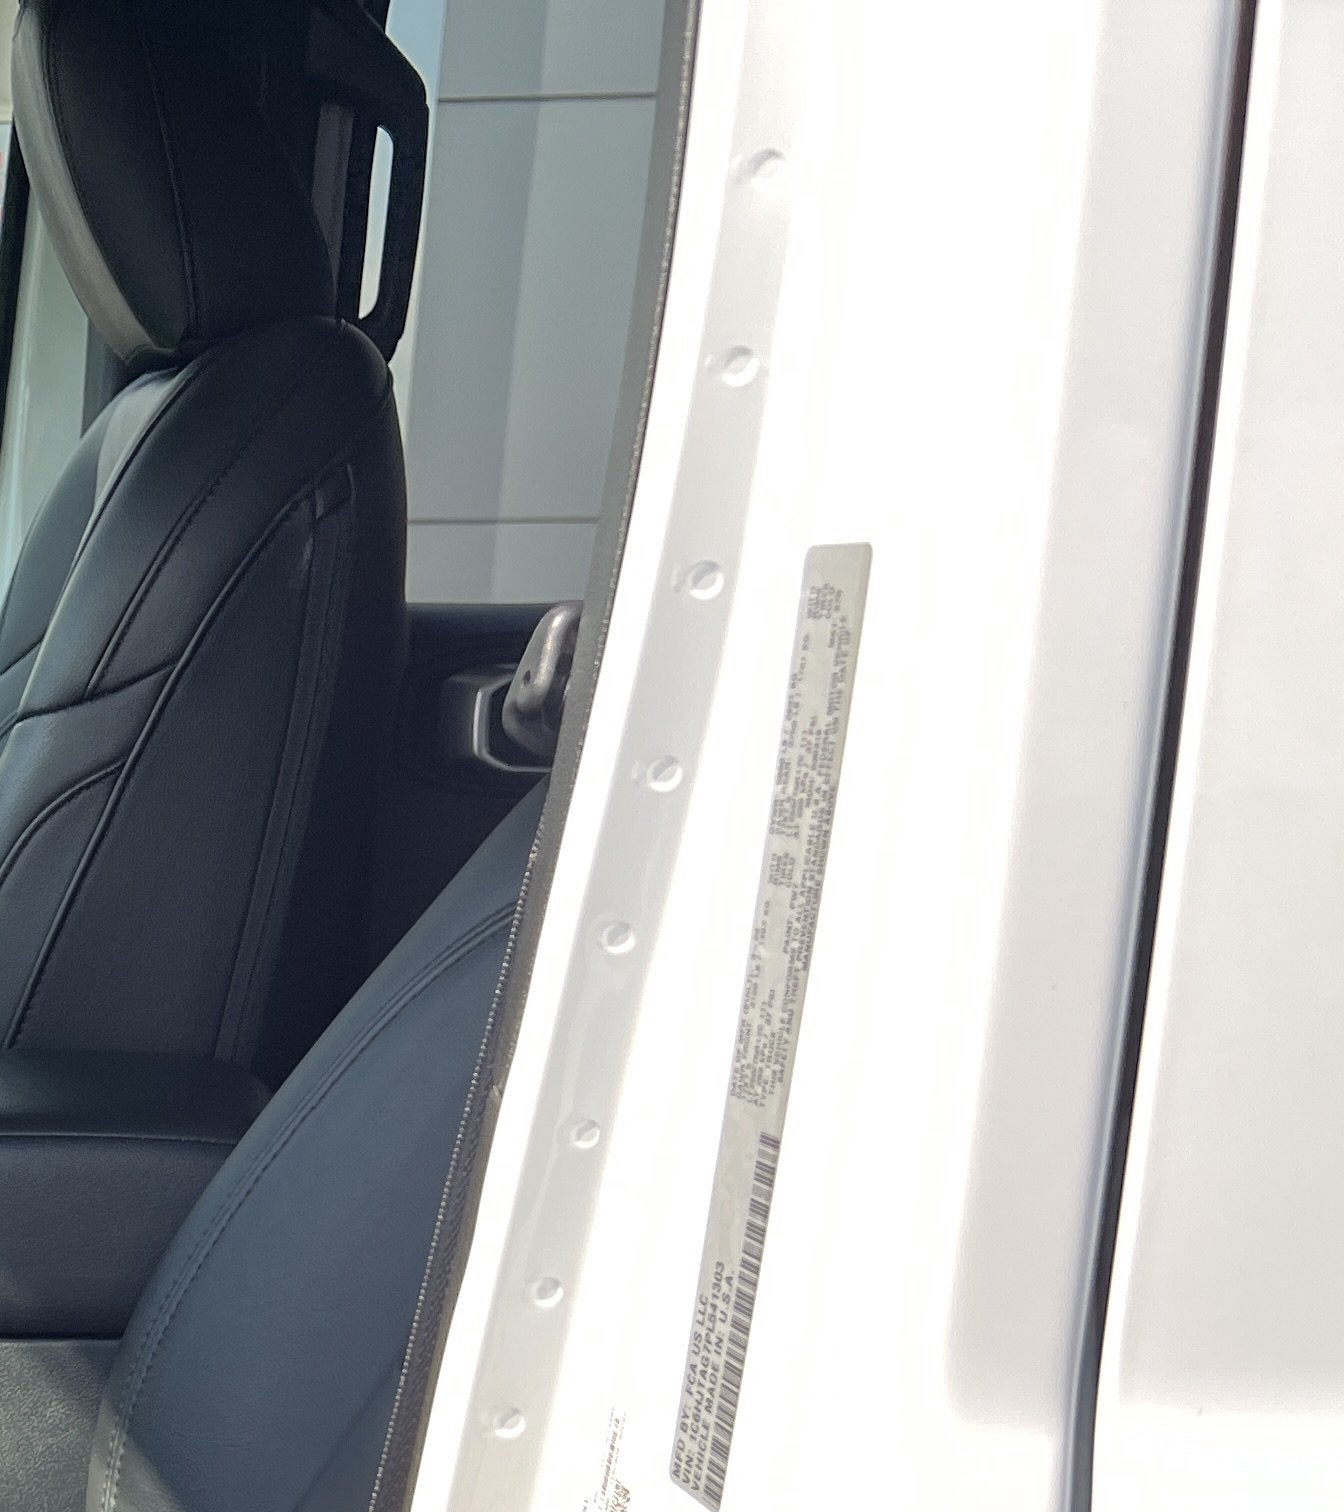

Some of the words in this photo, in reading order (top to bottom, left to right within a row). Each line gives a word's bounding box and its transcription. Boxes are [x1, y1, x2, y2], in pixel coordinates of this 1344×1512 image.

[694, 1292, 709, 1328] LLC
[690, 1329, 703, 1358] US
[684, 1359, 698, 1397] FCA
[690, 1416, 711, 1494] VEHICLE
[703, 1358, 720, 1415] MADE
[671, 1436, 686, 1479] MFD
